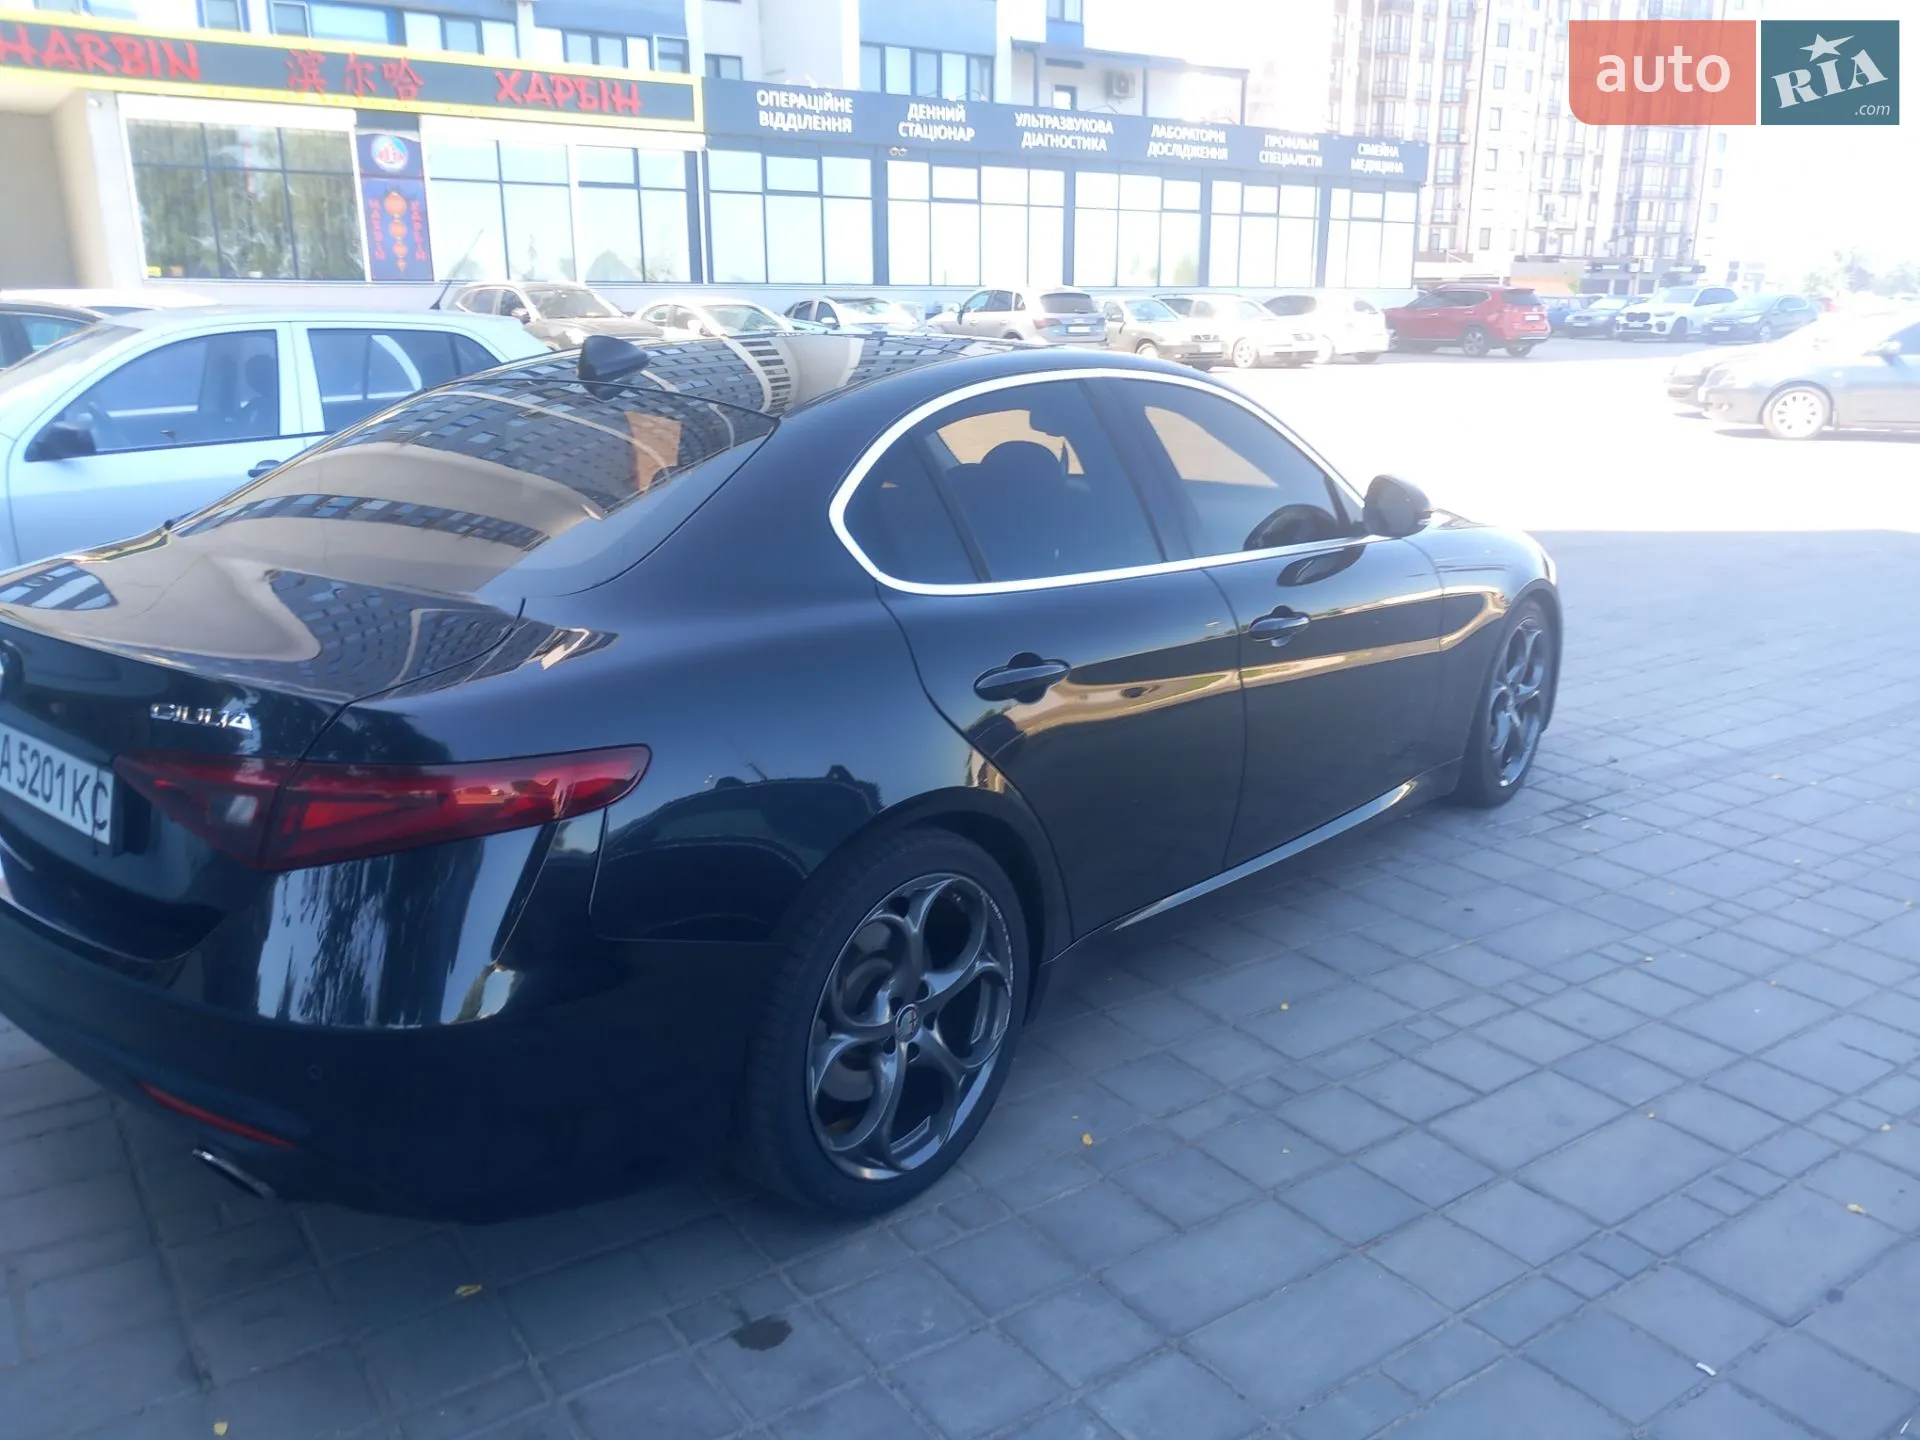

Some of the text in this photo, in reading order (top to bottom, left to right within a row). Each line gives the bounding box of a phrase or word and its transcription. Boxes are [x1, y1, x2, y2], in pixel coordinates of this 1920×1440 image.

[0, 23, 201, 82] HARBIN
[756, 89, 854, 114] ОПЕРАЦІЙНЕ
[907, 102, 966, 123] ДЕННИЙ
[758, 110, 853, 133] ВІДДІЛЕННЯ
[898, 121, 975, 142] СТАЦІОНАР
[1014, 112, 1114, 135] УЛЬТРАЗВУКОВА
[1021, 131, 1108, 151] ДІАГНОСТИКА
[1151, 124, 1226, 144] ЛАБОРАТОРНІ
[1147, 141, 1229, 161] ДОСЛІДЖЕННЯ
[149, 703, 254, 731] GIULIA
